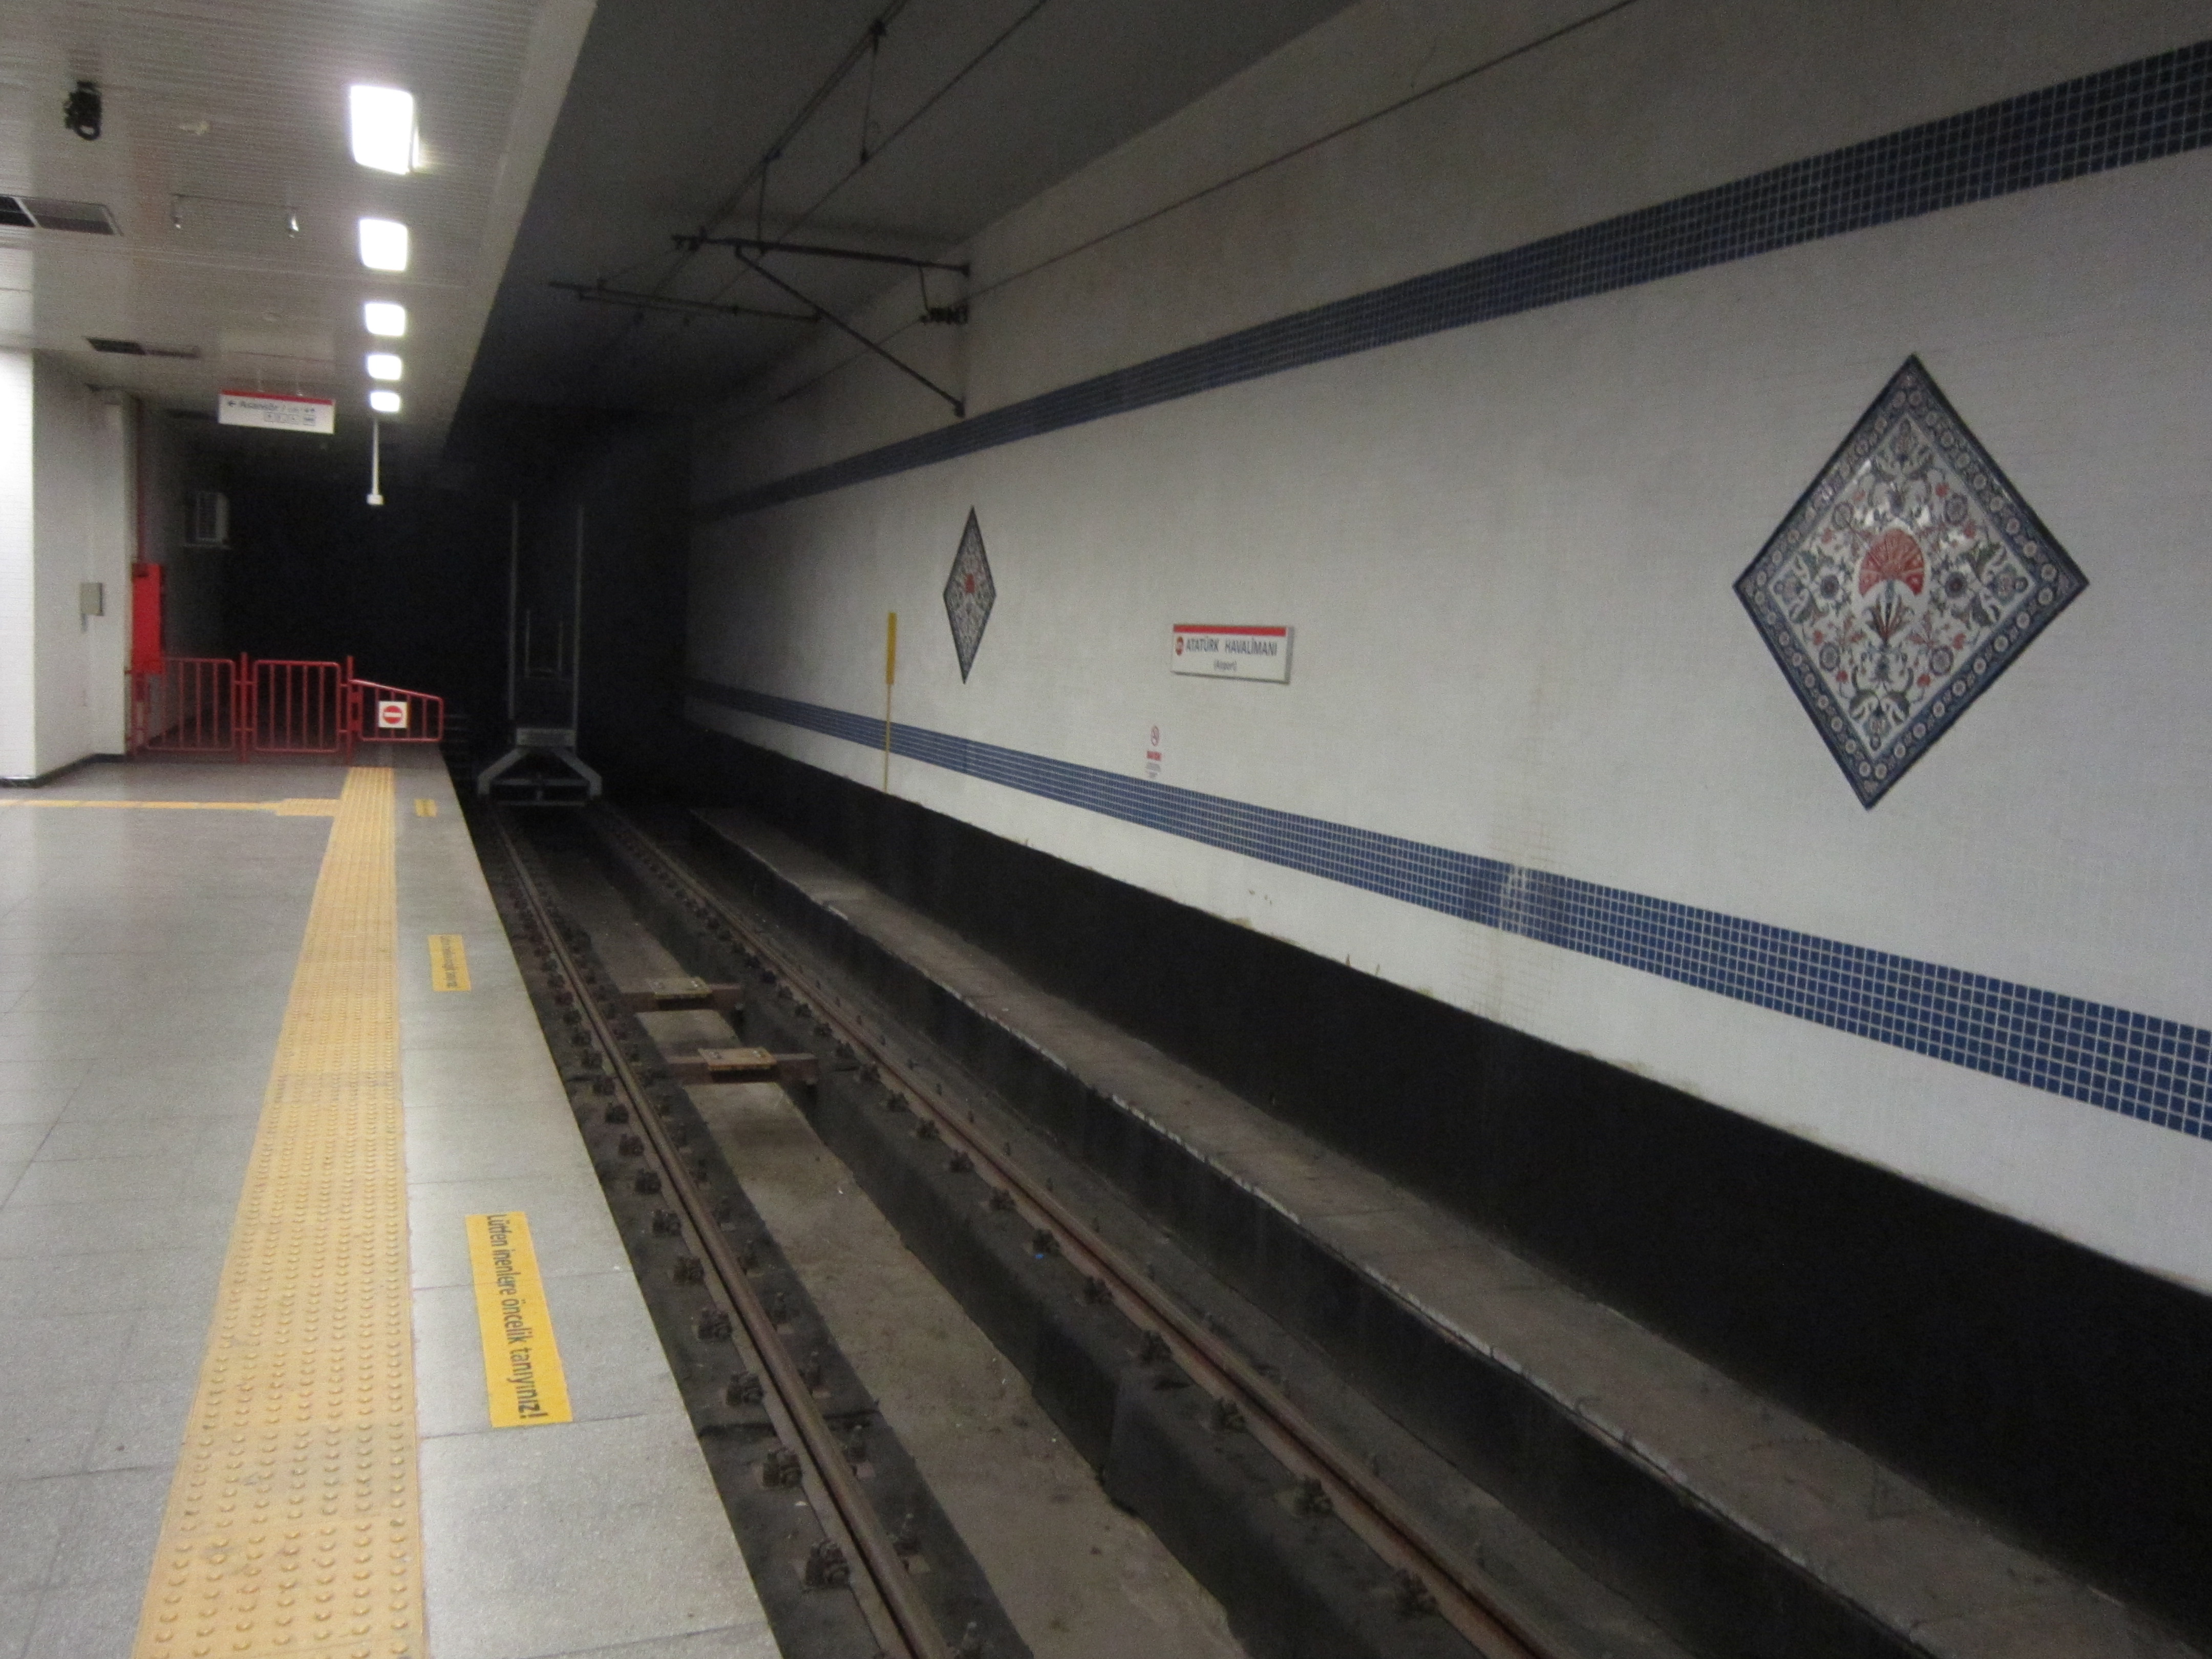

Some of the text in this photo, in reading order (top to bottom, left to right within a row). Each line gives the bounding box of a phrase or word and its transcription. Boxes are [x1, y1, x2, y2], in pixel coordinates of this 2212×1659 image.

[1186, 636, 1278, 656] ATATÜRK HAVALİMANI
[492, 1249, 521, 1295] inenlere
[501, 1299, 534, 1344] öncelik
